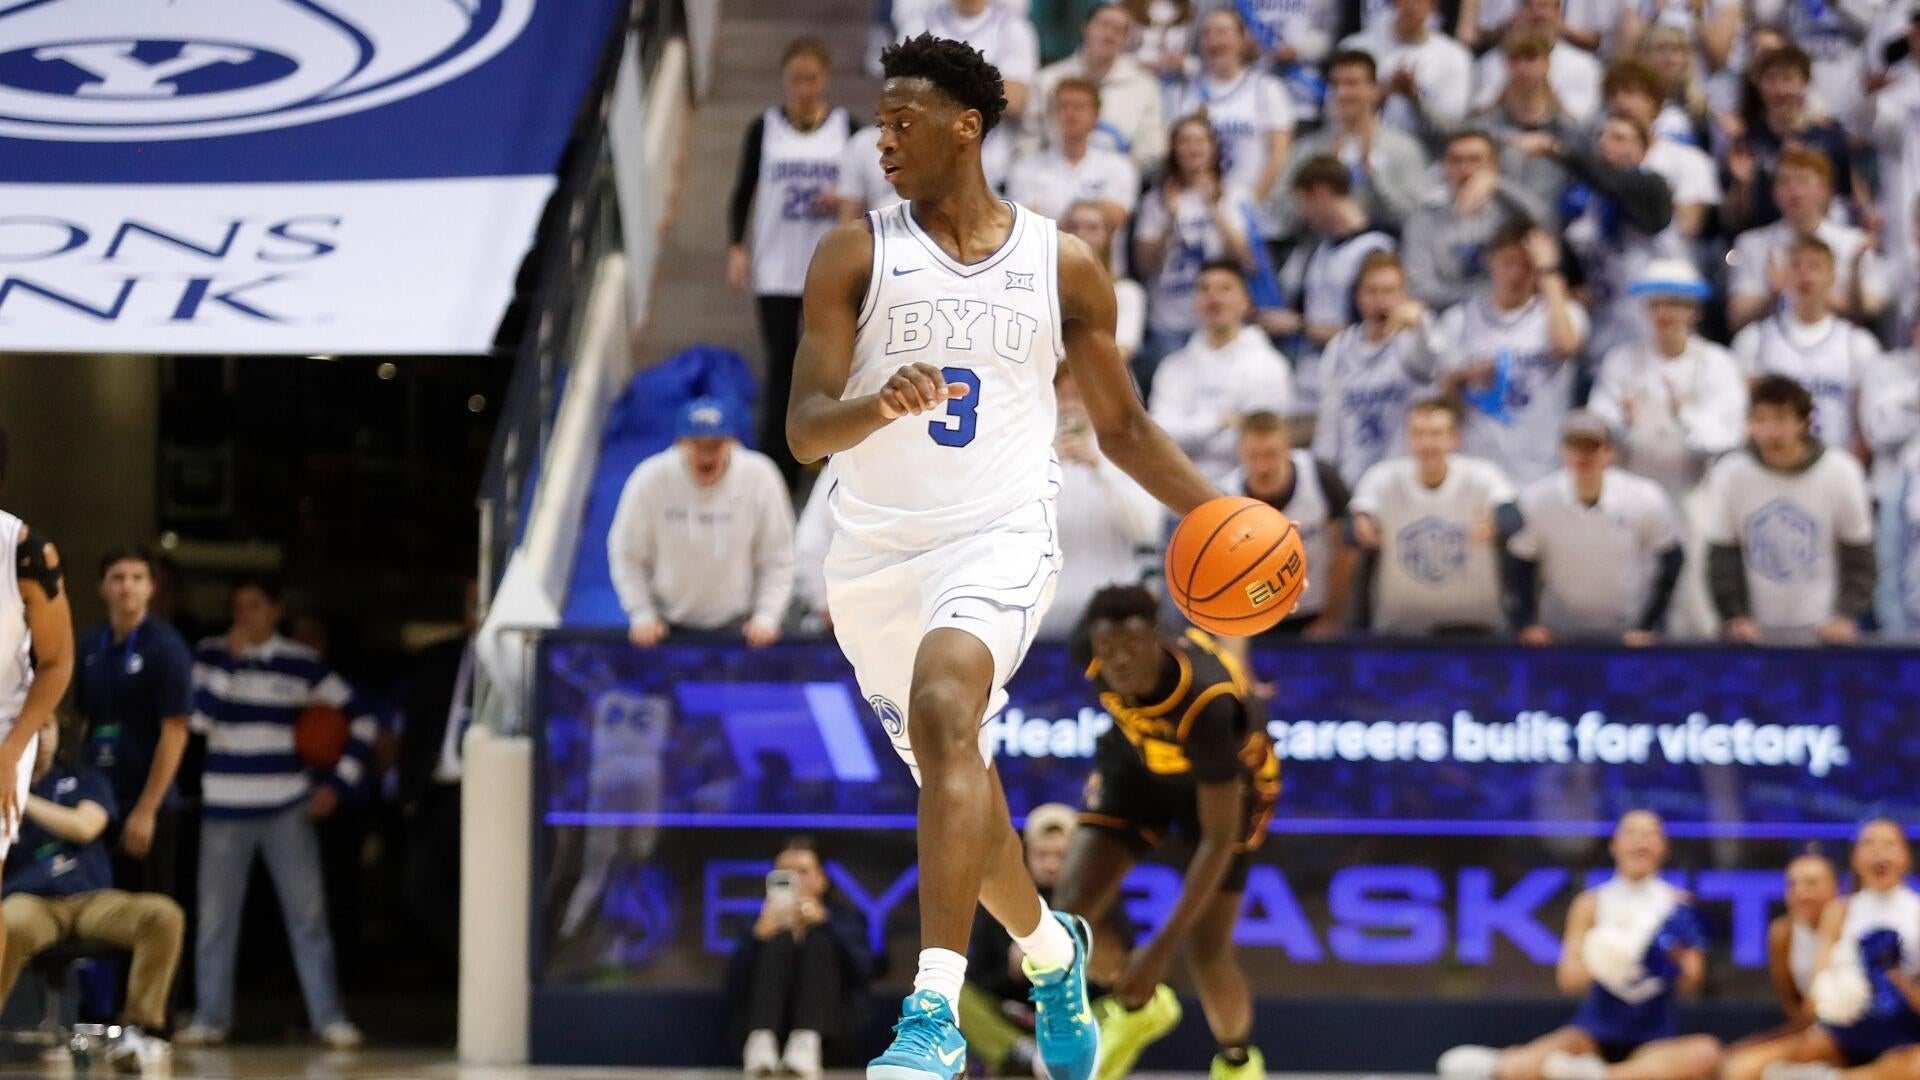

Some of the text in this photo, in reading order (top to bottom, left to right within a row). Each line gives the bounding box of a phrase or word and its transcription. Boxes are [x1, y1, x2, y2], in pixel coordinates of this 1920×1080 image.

[32, 41, 256, 97] Y
[885, 299, 1038, 364] BYU
[928, 366, 981, 448] 3
[1247, 549, 1301, 607] ELITE
[1452, 709, 1572, 763] built
[1573, 710, 1655, 764] for
[1656, 711, 1849, 777] victory.
